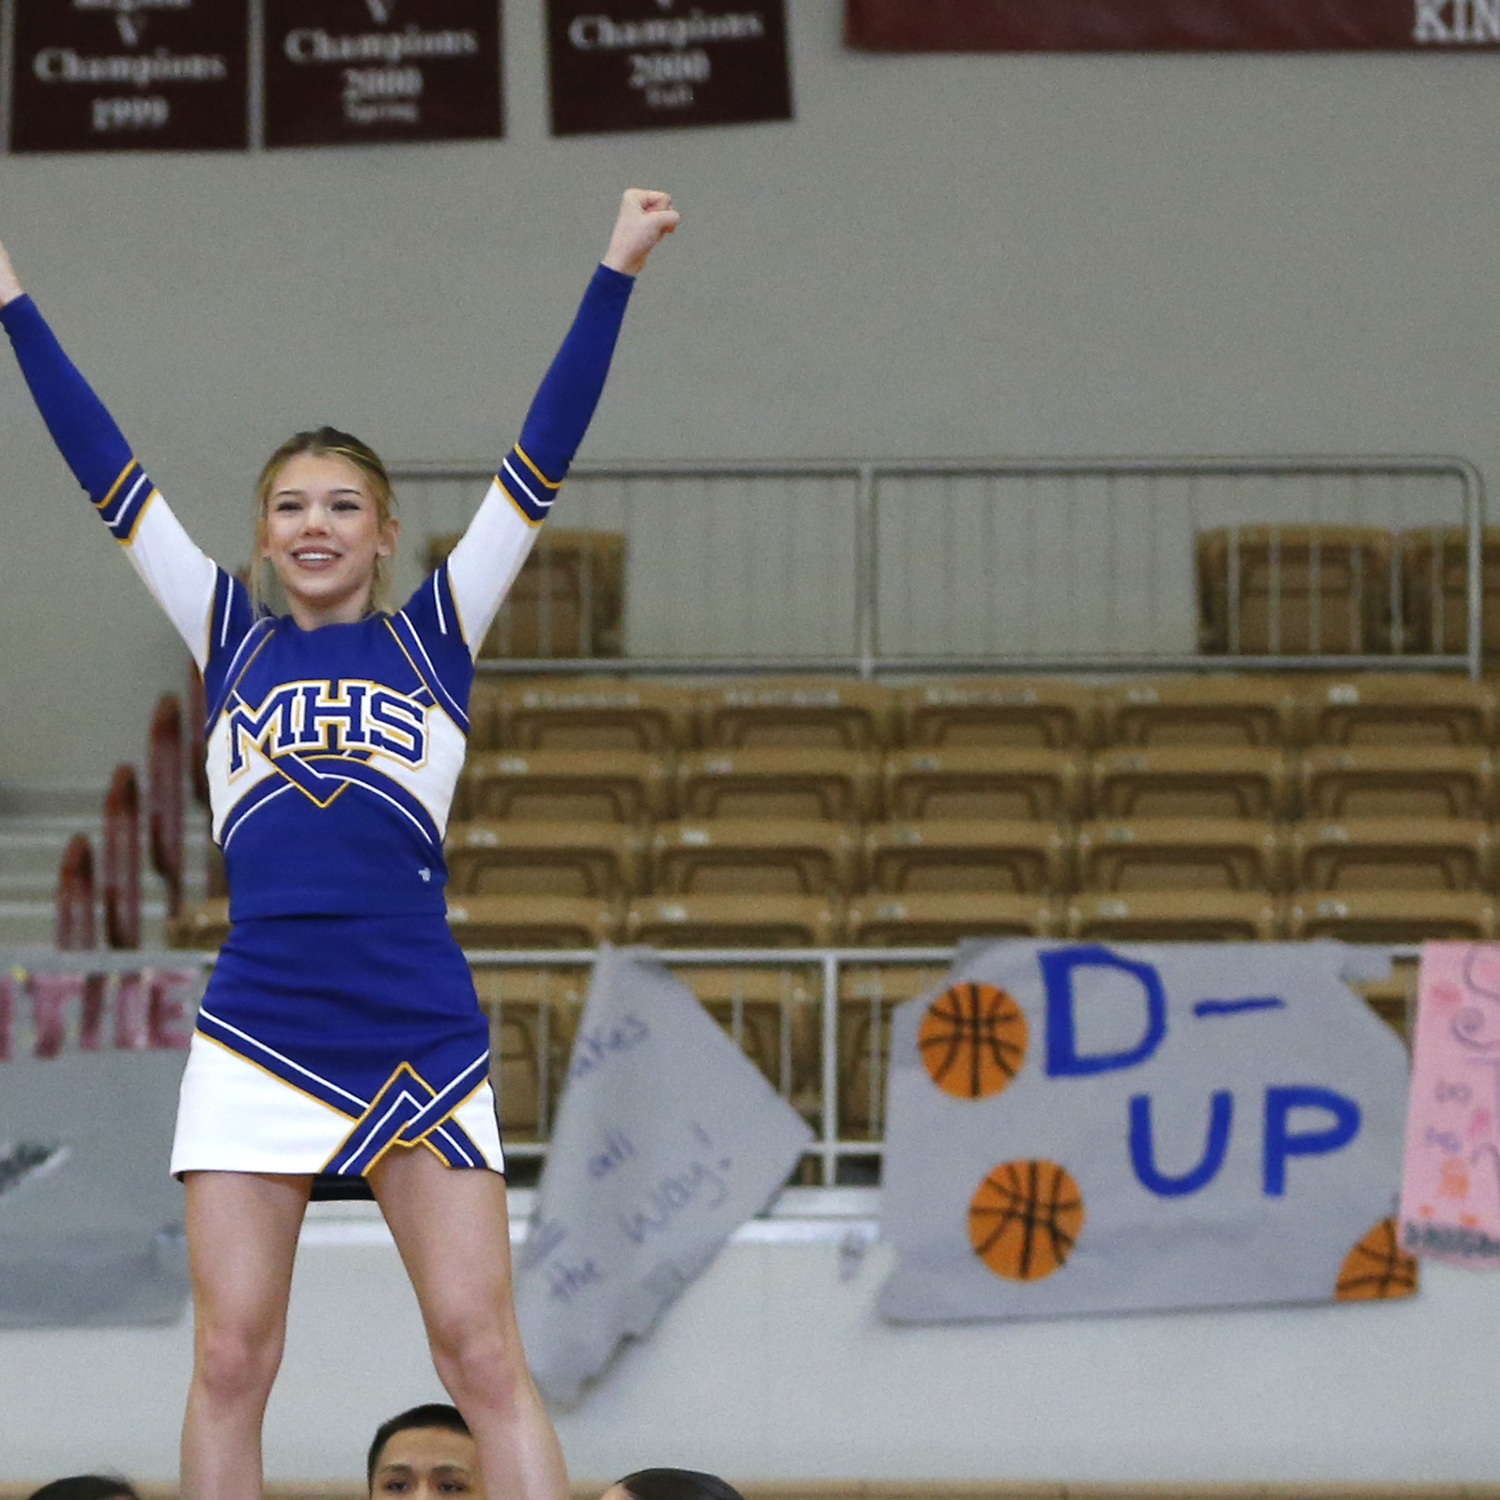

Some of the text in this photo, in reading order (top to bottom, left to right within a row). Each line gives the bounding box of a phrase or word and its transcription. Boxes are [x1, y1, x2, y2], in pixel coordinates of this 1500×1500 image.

[284, 25, 479, 64] Champions
[568, 10, 764, 51] Champions
[32, 46, 227, 88] Champions
[343, 66, 424, 101] 2000
[629, 50, 712, 88] 2000
[228, 679, 430, 785] MHS
[1130, 1086, 1362, 1197] UP
